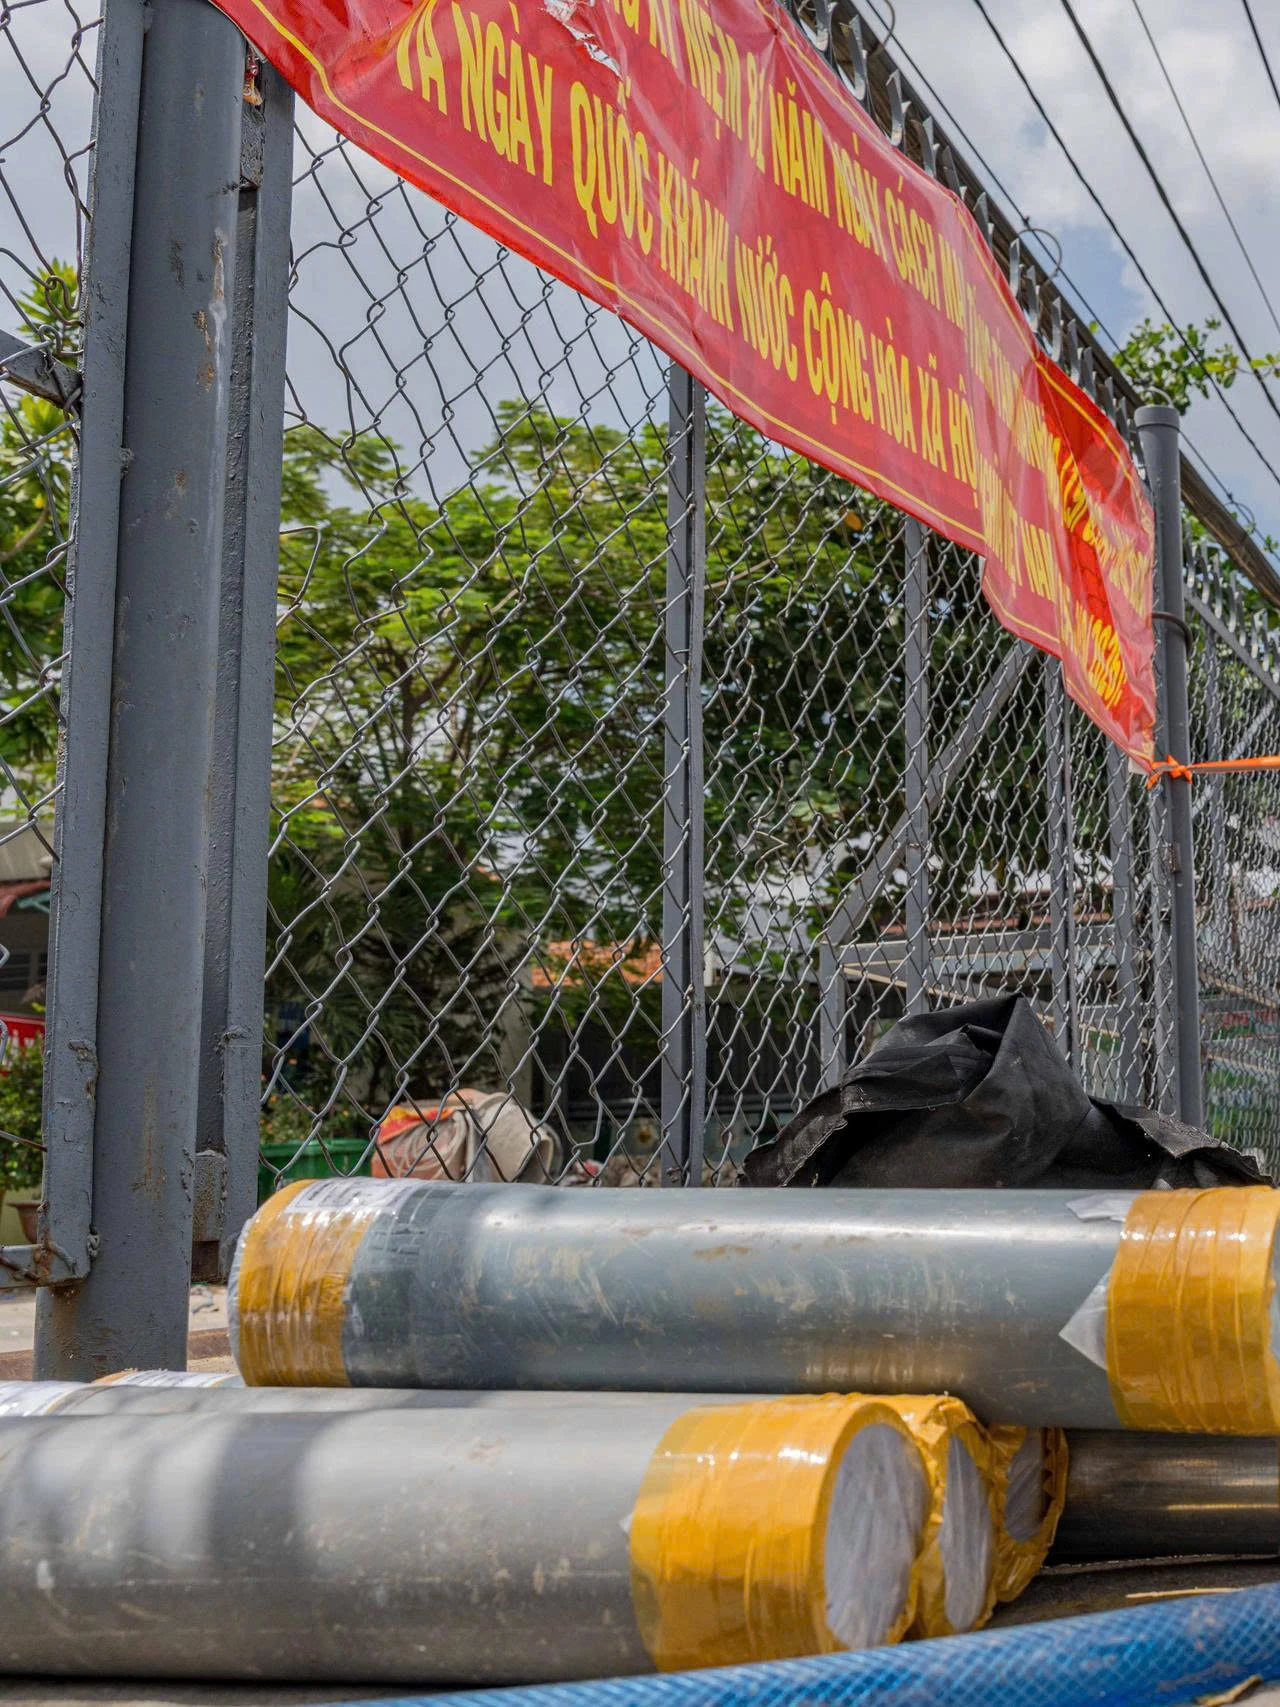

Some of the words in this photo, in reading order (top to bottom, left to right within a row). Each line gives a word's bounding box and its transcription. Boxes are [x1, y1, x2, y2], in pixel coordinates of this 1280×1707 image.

[452, 1, 553, 187] NGÀY
[570, 75, 654, 256] QUỐC
[657, 151, 735, 333] KHÁNH
[735, 234, 798, 382] NƯỚC
[803, 271, 874, 425] CỘNG
[869, 316, 918, 454] HÒA
[918, 353, 948, 473] XÃ
[769, 77, 831, 219] NĂM
[832, 131, 889, 264] NGÀY
[885, 175, 941, 312] CÁCH
